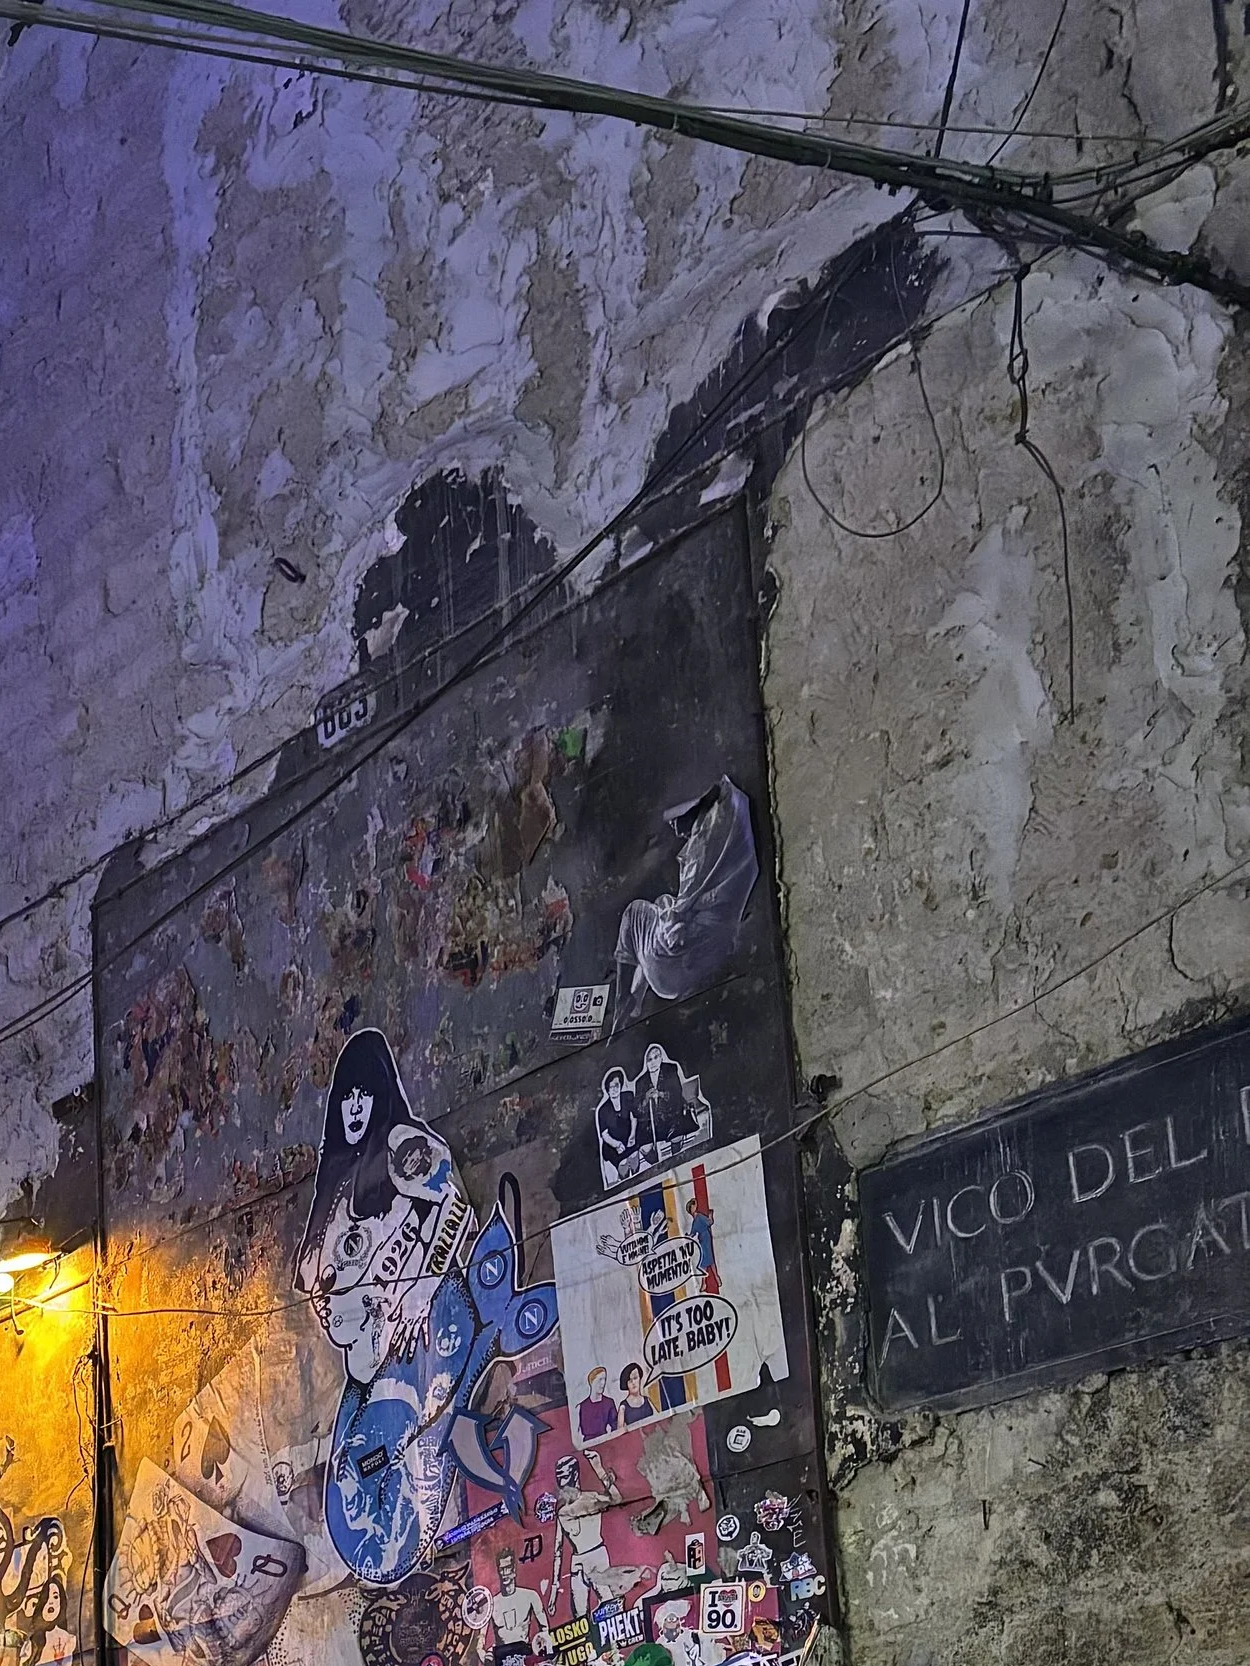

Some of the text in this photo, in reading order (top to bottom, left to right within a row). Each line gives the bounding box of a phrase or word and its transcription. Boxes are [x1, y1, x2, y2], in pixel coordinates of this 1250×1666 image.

[882, 1169, 1035, 1254] VICO
[1067, 1115, 1208, 1203] DEL
[372, 1222, 419, 1291] 1926
[641, 1247, 678, 1278] ASPETTA
[650, 1316, 732, 1367] LATE, BABY!
[660, 1299, 715, 1339] IT'S TOO
[879, 1295, 964, 1368] AL
[791, 1575, 826, 1601] RBC
